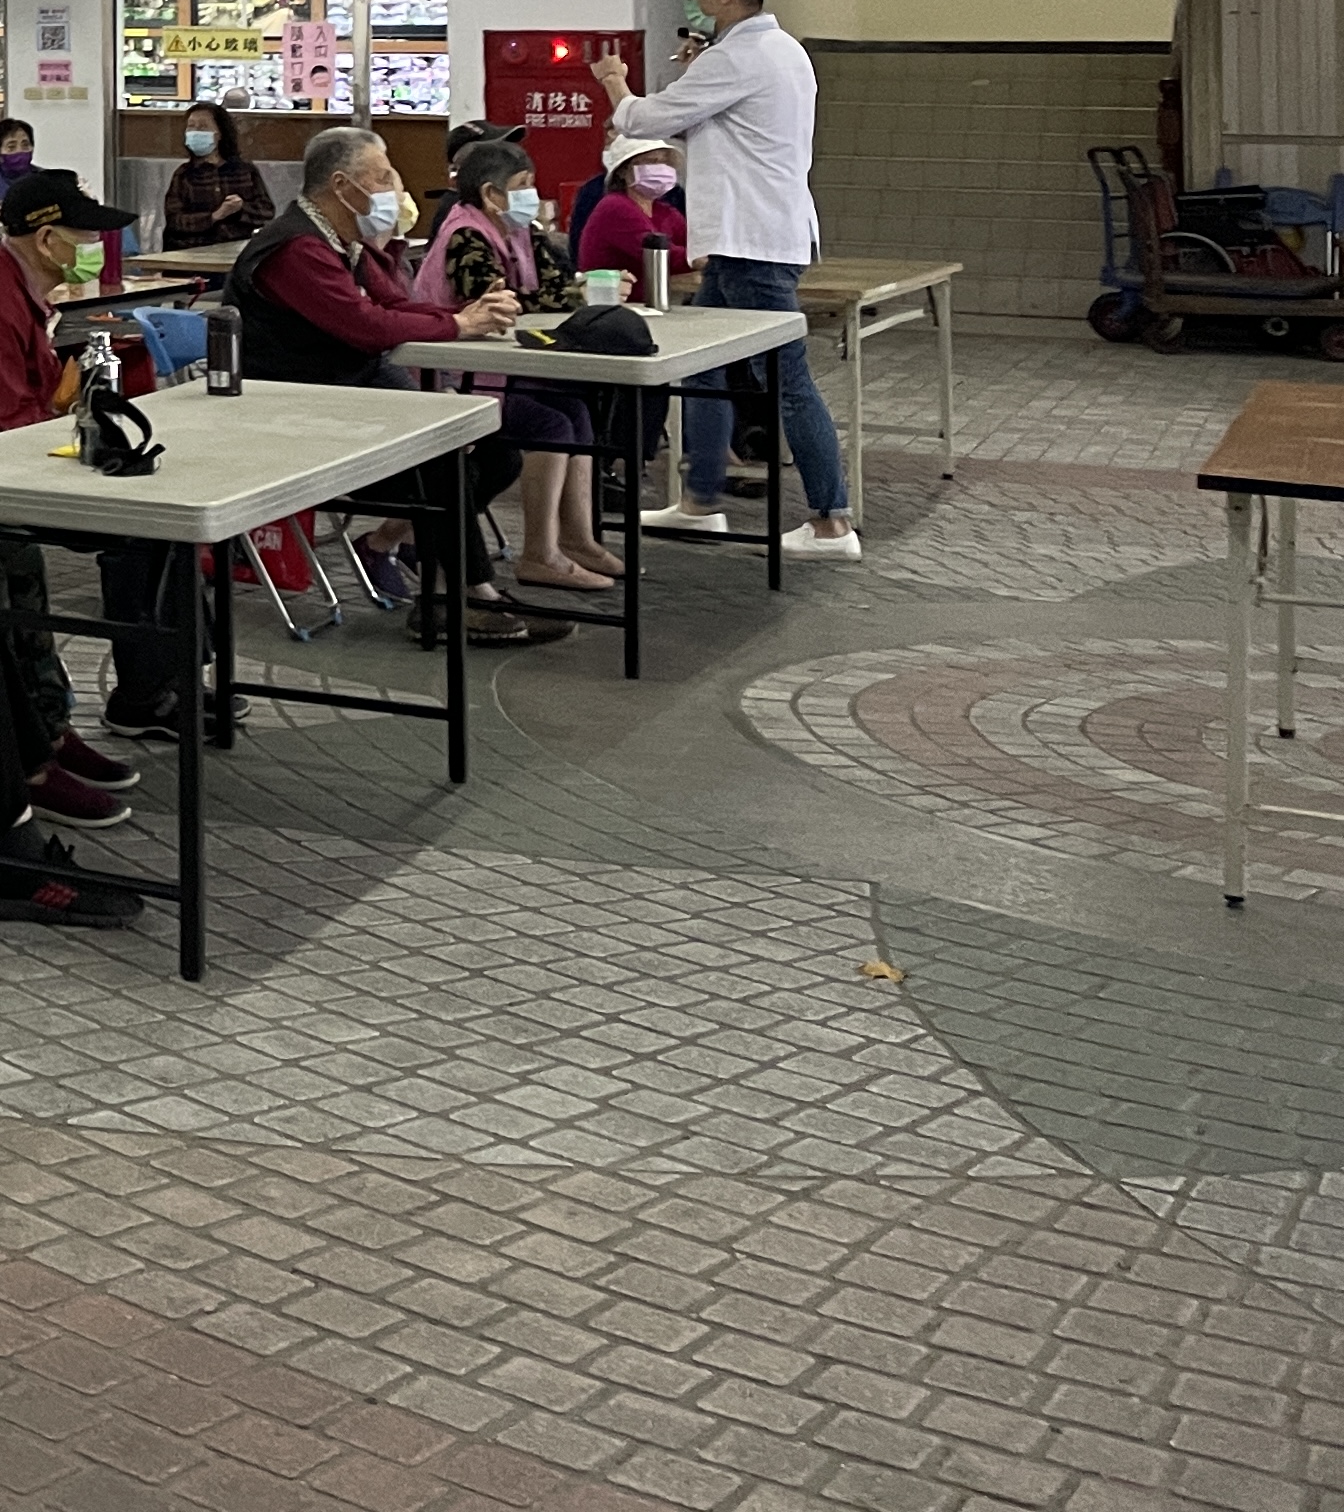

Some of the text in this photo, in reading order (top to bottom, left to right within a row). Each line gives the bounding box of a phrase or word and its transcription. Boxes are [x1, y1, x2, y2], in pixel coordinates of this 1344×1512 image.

[187, 36, 259, 53] 小心玻璃
[313, 25, 328, 58] 入口
[525, 91, 593, 112] 消防栓
